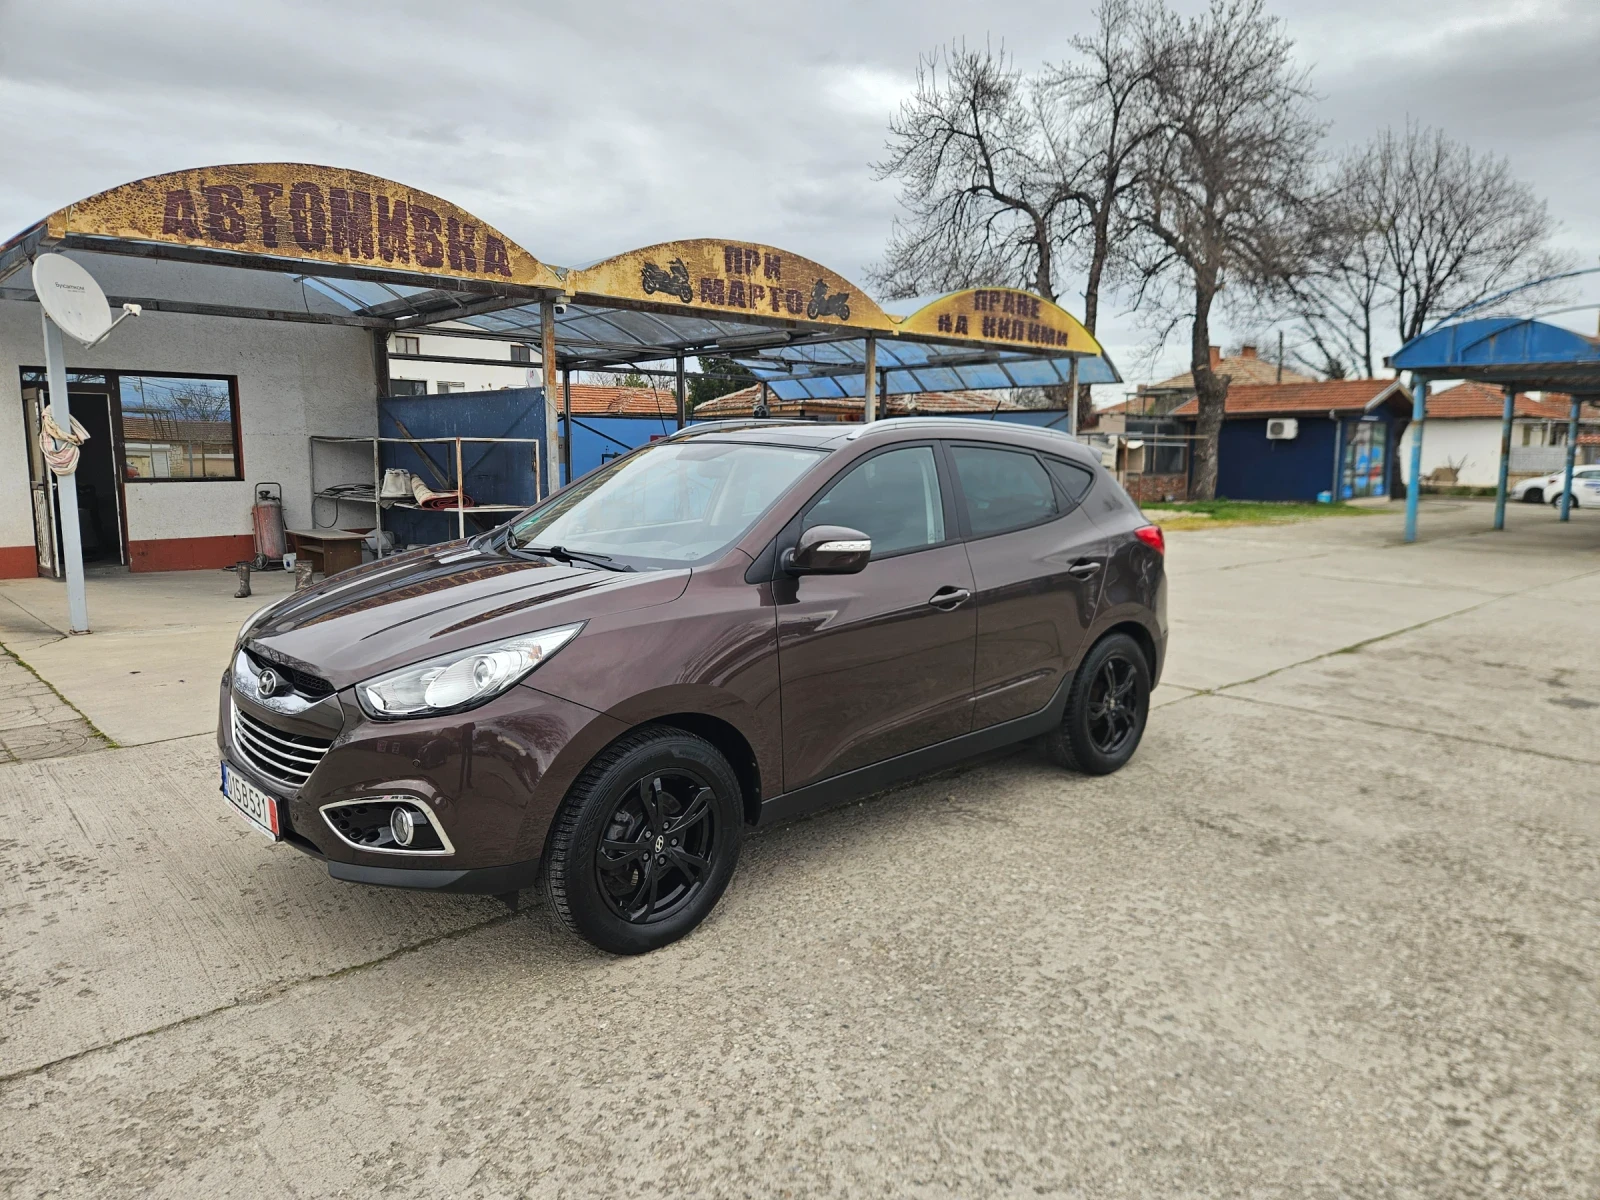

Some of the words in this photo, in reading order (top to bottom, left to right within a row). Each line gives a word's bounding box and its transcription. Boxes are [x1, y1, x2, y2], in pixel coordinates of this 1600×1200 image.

[163, 182, 513, 277] АВТОМИВКА
[725, 246, 781, 282] ПРИ
[701, 277, 803, 315] МАРТО
[974, 289, 1040, 320] ПРАНЕ
[938, 313, 969, 336] НА
[982, 315, 1068, 347] КИЛИМИ
